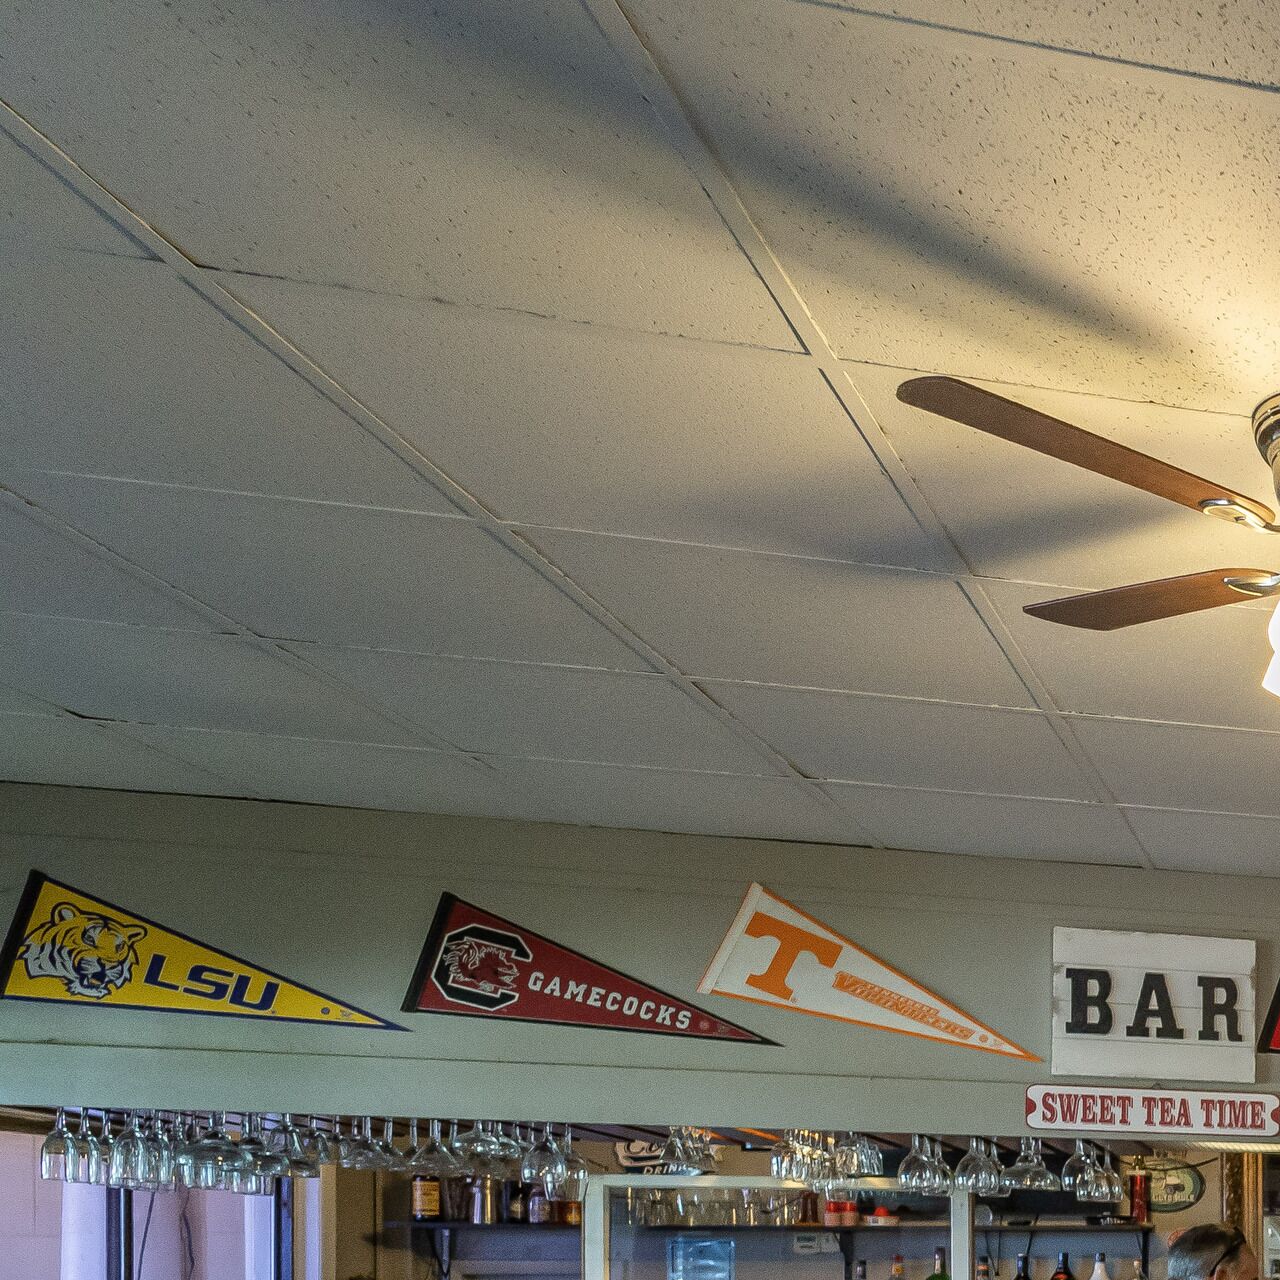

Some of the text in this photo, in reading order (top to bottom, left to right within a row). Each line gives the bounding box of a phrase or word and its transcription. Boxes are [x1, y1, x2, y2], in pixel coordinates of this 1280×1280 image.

[143, 954, 281, 1012] LSU
[527, 971, 692, 1031] GAMECOCKS
[1065, 967, 1243, 1042] BAR
[1041, 1091, 1266, 1131] SWEET TEA TIME
